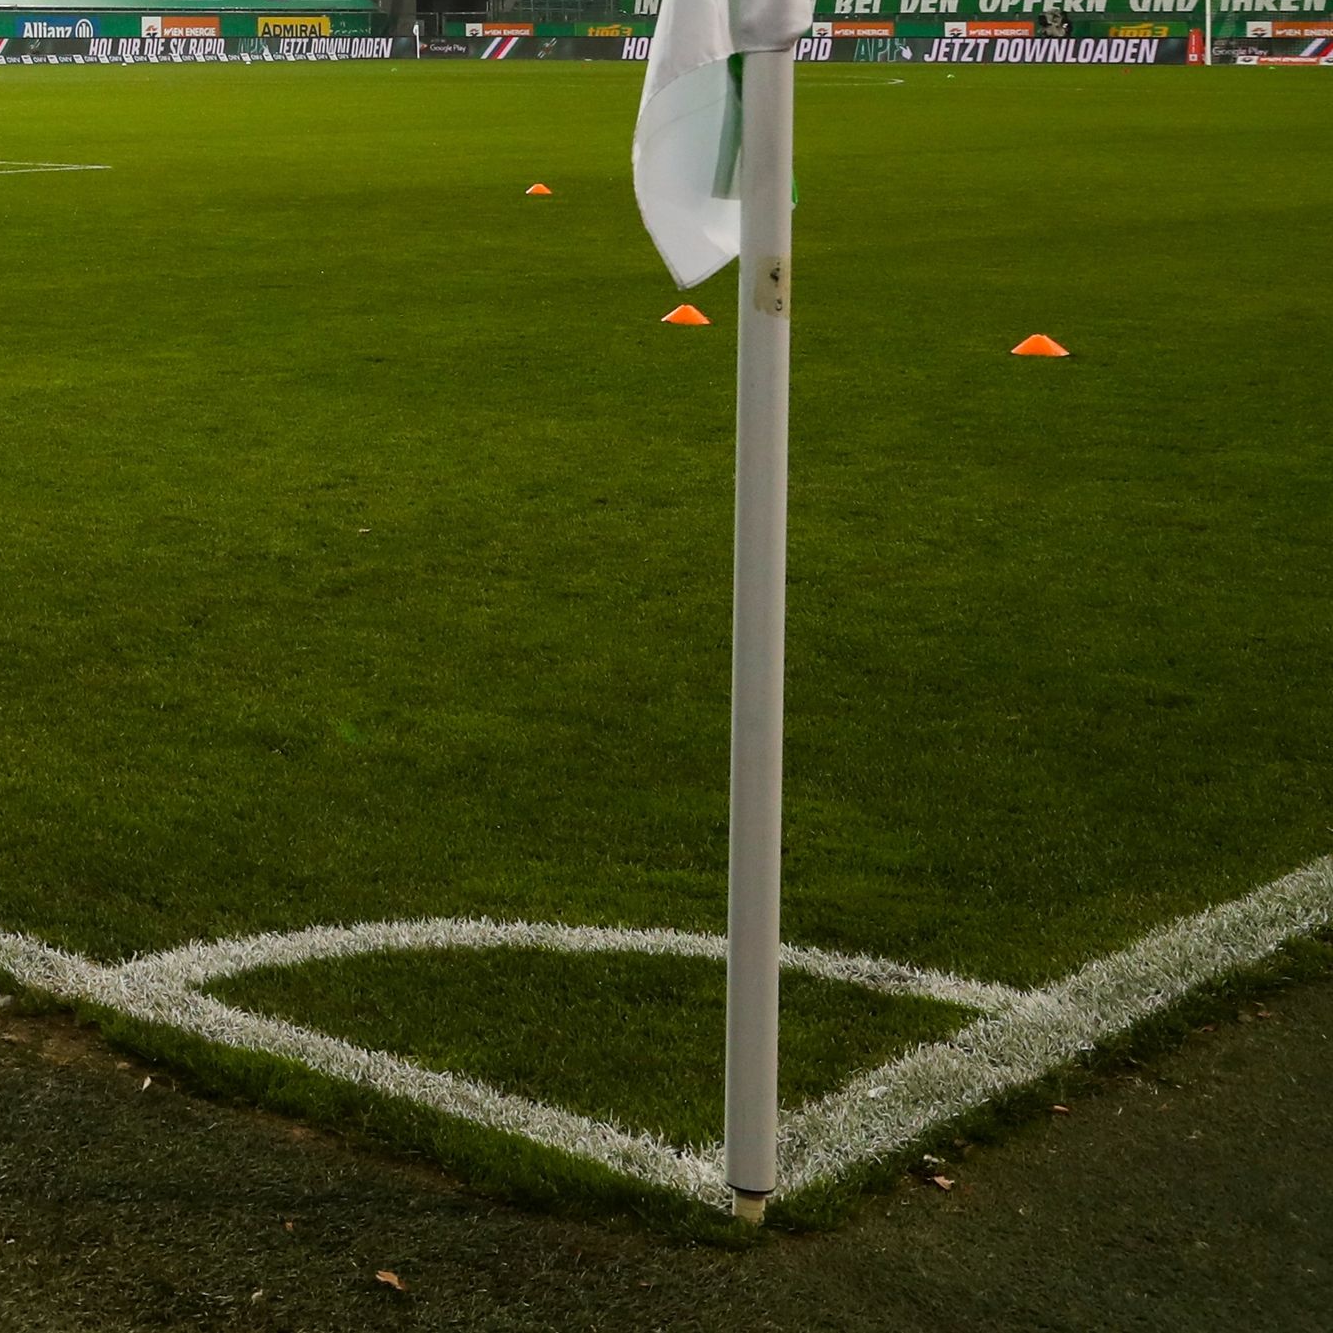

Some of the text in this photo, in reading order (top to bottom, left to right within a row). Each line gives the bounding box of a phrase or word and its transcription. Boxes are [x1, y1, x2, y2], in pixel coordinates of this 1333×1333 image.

[22, 21, 73, 39] Allianz
[163, 26, 217, 37] WIEN ENERGIE
[261, 21, 329, 38] ADMIRAL
[429, 43, 467, 54] Google Play
[924, 38, 991, 63] JETZT
[992, 38, 1159, 64] DOWNLOADEN
